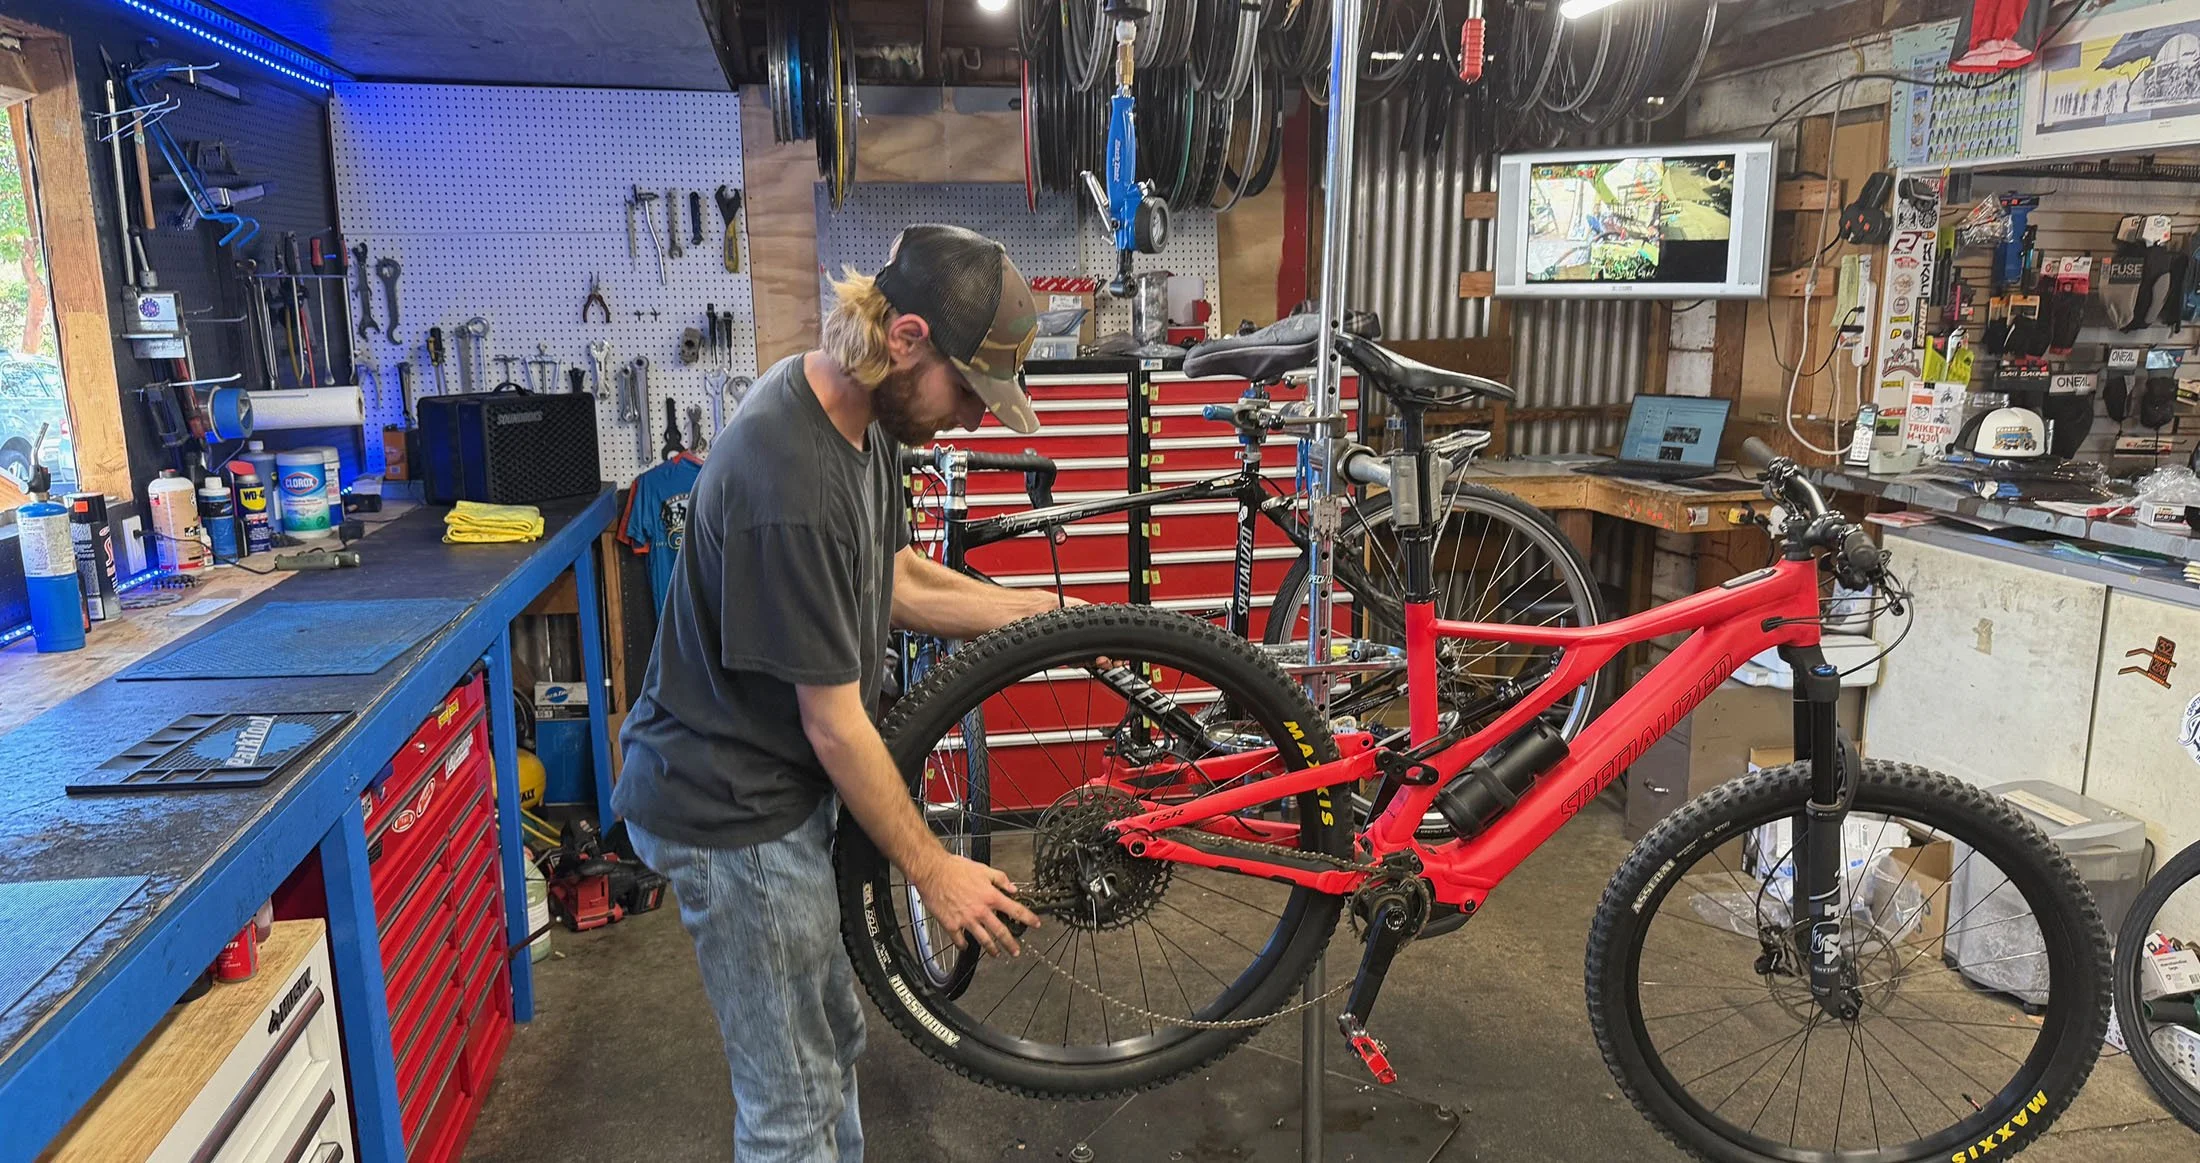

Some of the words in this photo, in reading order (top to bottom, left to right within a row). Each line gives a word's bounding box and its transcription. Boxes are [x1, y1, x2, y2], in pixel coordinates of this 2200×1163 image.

[1920, 263, 1931, 296] KALI
[2111, 264, 2144, 275] FUSE
[243, 490, 265, 501] WD-4
[285, 478, 315, 488] CLOROX
[1237, 525, 1253, 616] SPECIALIZED
[225, 715, 278, 767] ParkTool
[1561, 653, 1733, 822] SPECIALIZED
[1149, 809, 1184, 825] FSR
[889, 973, 961, 1048] AGGRESSOR
[1951, 1089, 2048, 1163] MAXXIS
